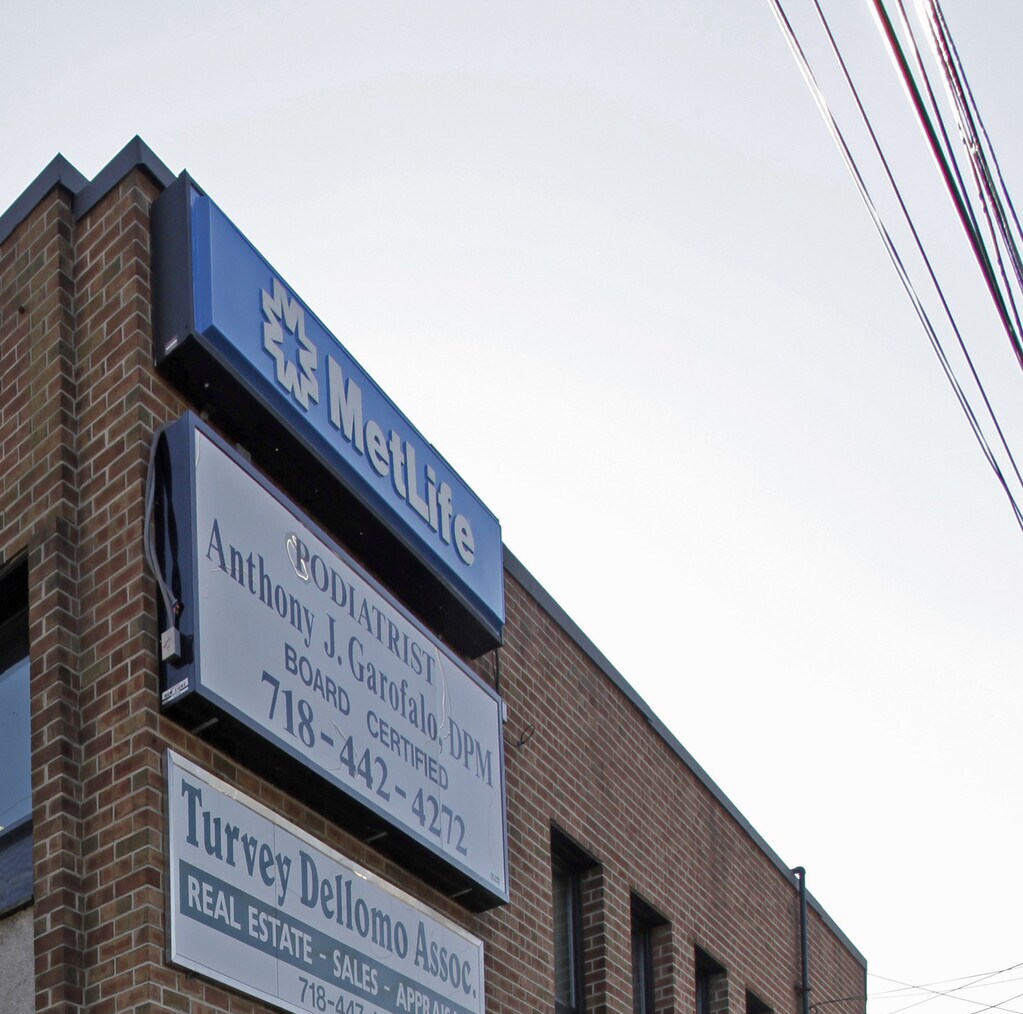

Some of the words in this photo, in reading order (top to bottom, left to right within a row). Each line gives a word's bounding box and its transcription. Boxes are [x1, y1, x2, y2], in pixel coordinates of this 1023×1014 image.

[328, 354, 475, 566] MetLife
[206, 517, 315, 648] Anthony
[324, 614, 343, 666] J.
[348, 636, 443, 754] Garofalo,
[447, 715, 494, 788] DPM
[296, 536, 435, 686] PODIATRIST
[261, 670, 468, 856] 718-442-4272
[284, 642, 351, 716] BOARD
[366, 709, 449, 790] CERTIFIED
[181, 778, 292, 906] Turvey
[298, 850, 408, 960] Dellomo
[414, 920, 476, 999] Assoc.
[187, 874, 241, 931] REAL
[248, 905, 313, 965] ESTATE
[333, 949, 378, 996] SALES
